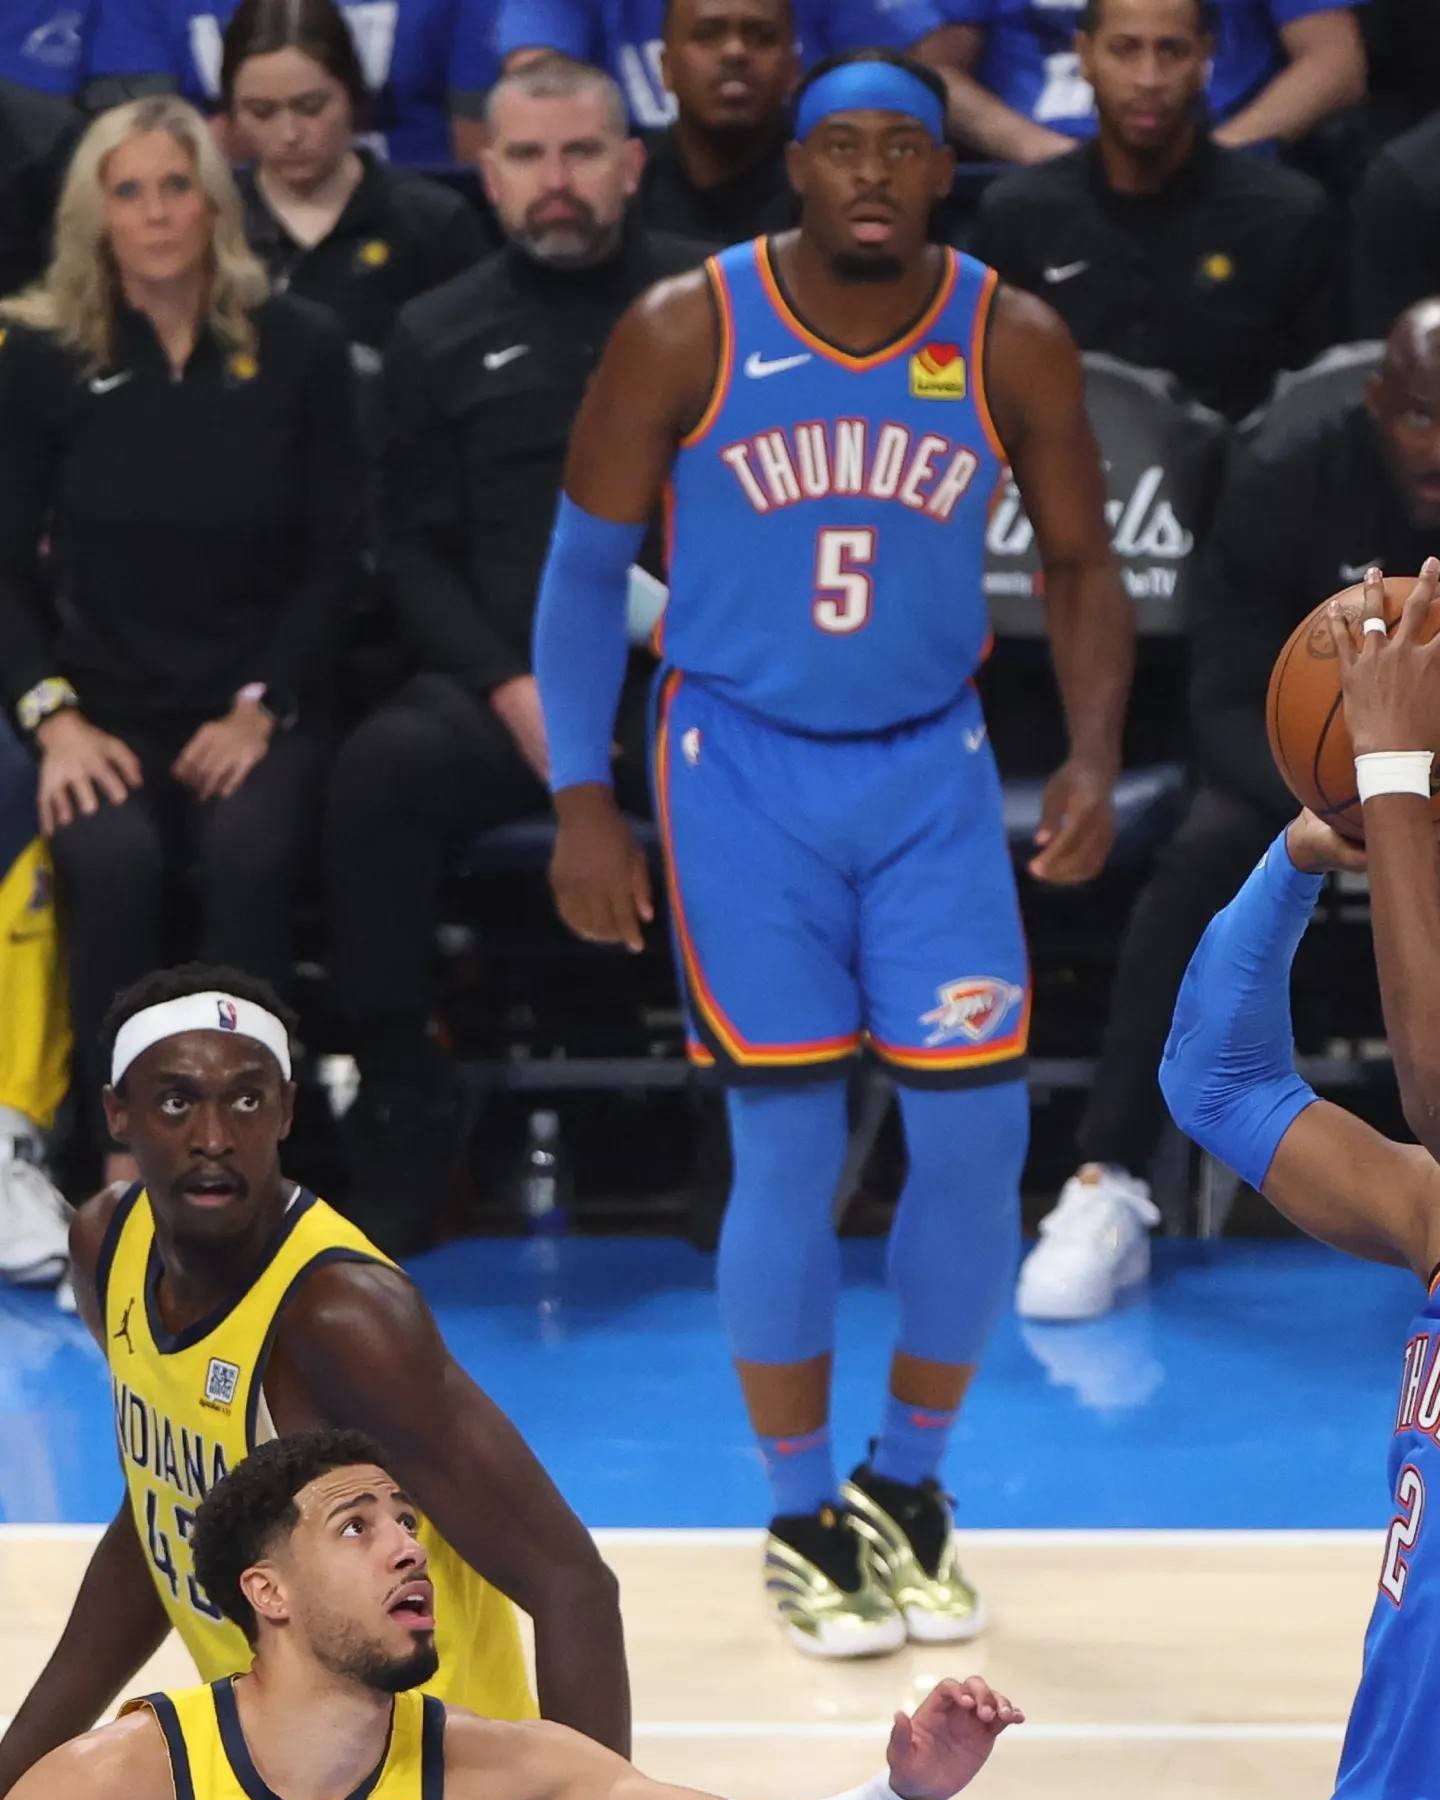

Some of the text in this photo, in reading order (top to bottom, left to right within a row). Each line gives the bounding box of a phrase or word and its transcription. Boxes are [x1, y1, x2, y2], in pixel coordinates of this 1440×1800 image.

[719, 416, 980, 524] THUNDER
[811, 524, 878, 636] 5
[112, 1373, 228, 1504] NDIANA
[1379, 1463, 1425, 1610] 2
